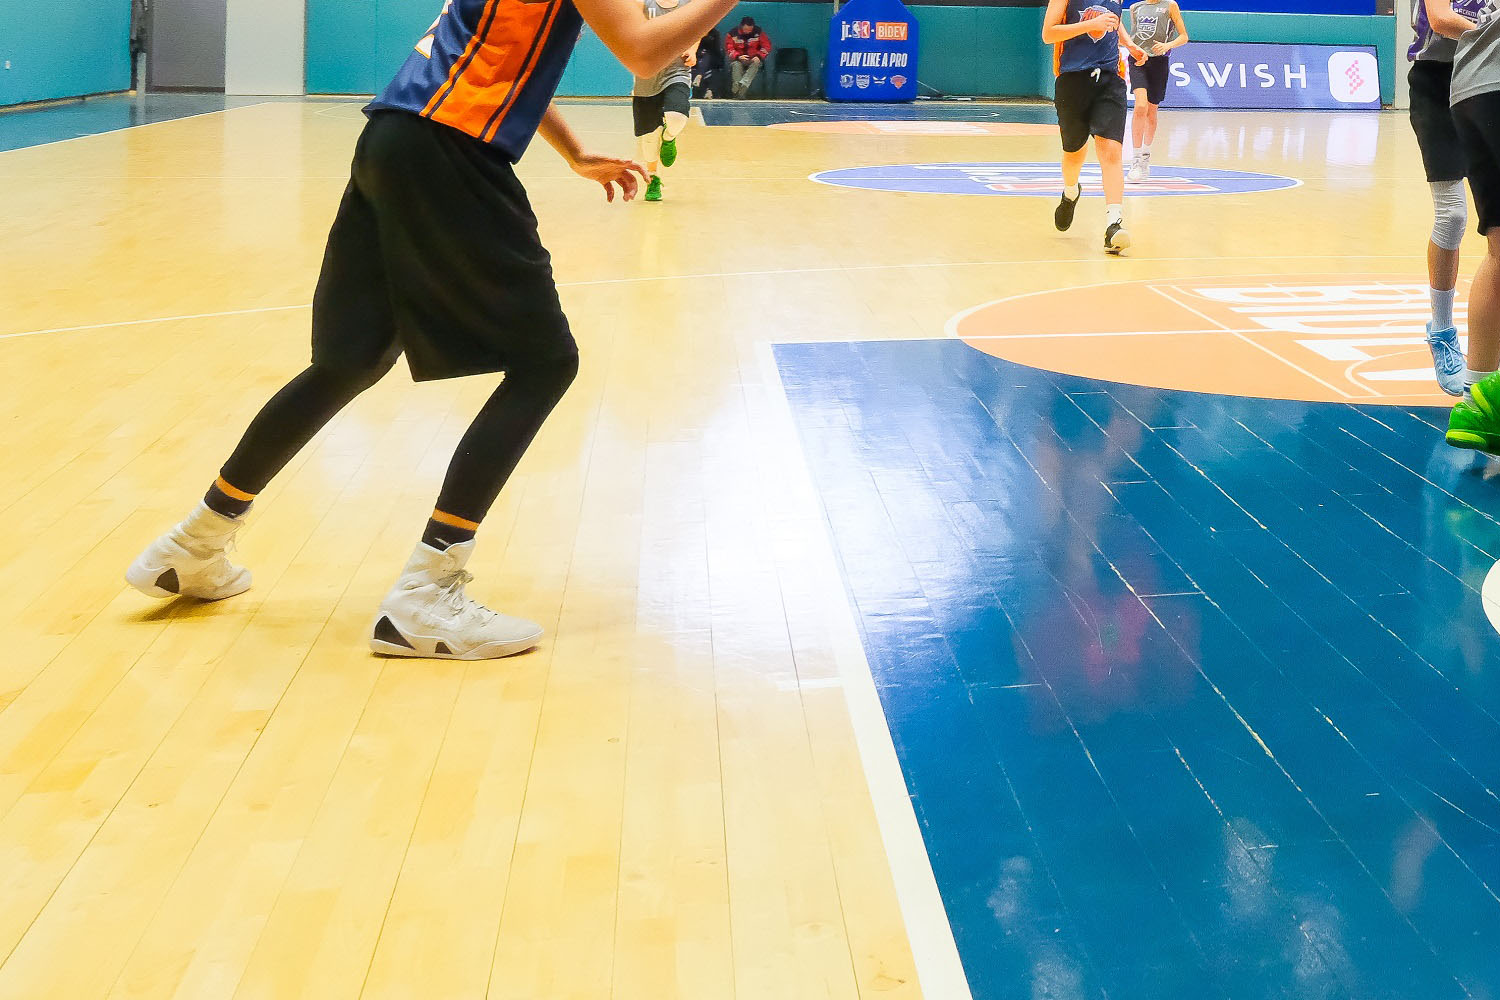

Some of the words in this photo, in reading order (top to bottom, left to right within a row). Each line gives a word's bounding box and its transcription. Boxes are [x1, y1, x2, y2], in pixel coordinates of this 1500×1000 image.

[840, 52, 862, 67] PLAY
[862, 52, 881, 67] LIKE
[881, 53, 889, 68] A
[889, 53, 908, 69] PRO
[1169, 61, 1307, 89] SWISH
